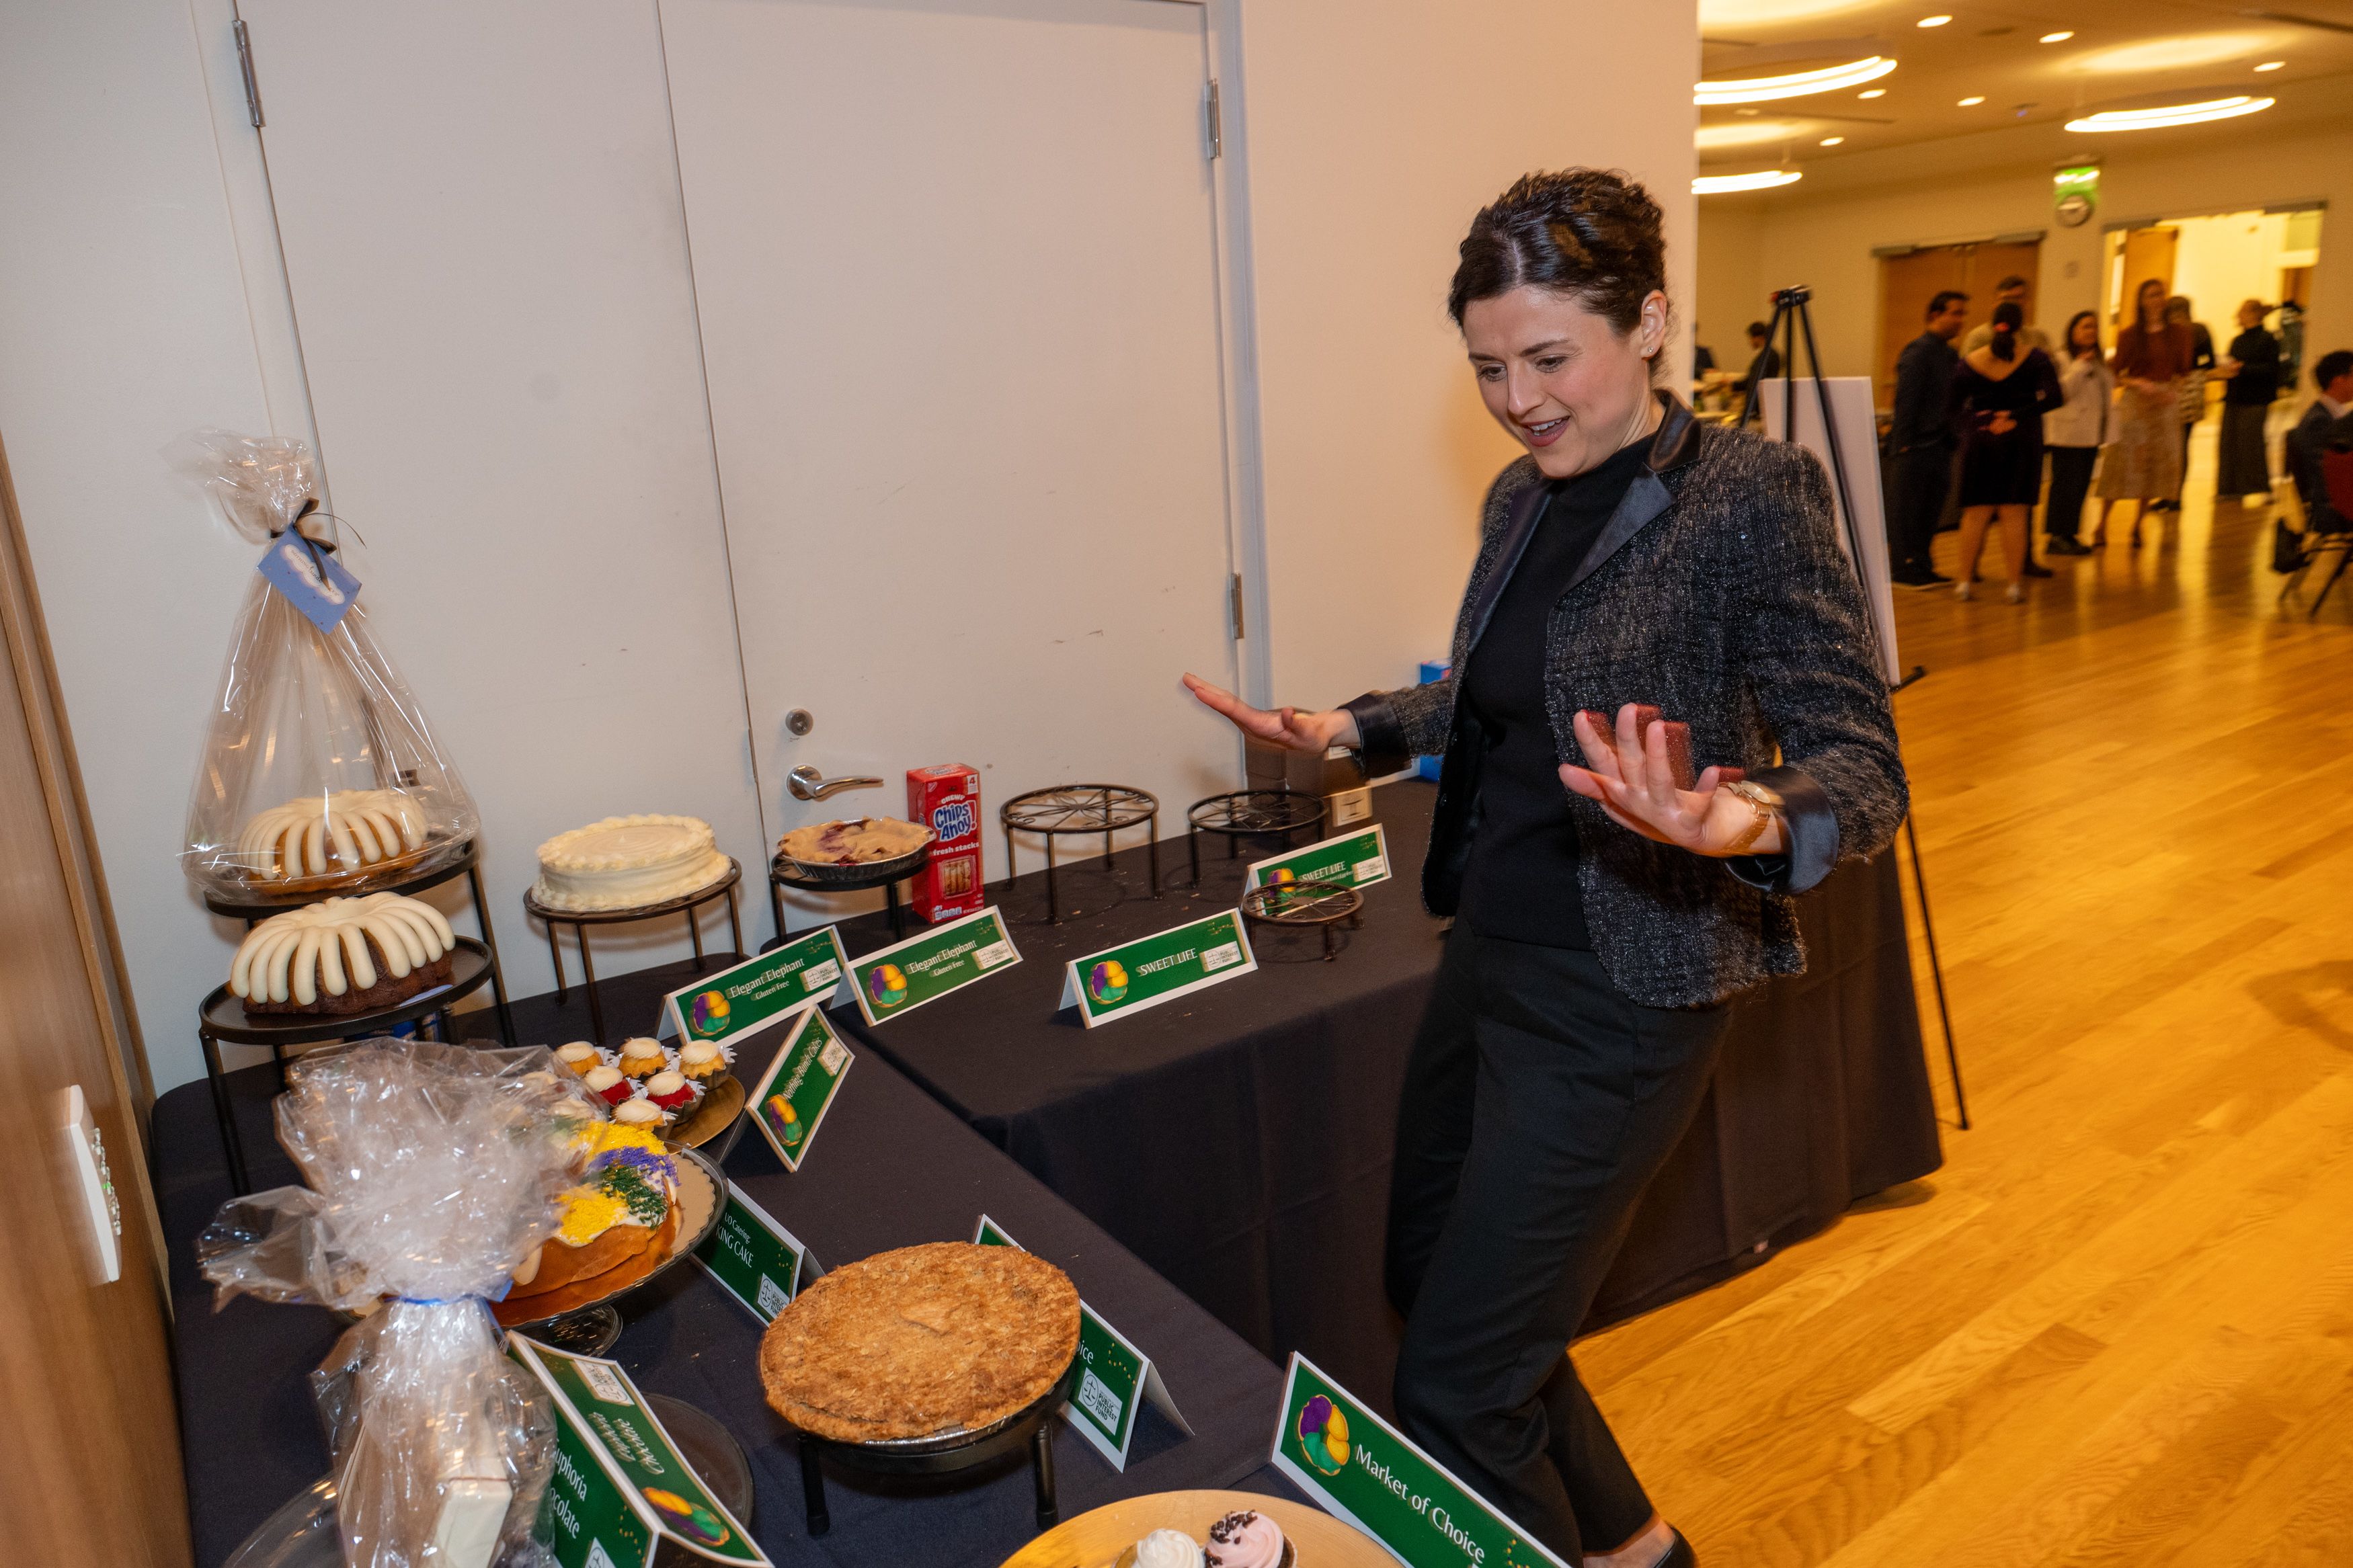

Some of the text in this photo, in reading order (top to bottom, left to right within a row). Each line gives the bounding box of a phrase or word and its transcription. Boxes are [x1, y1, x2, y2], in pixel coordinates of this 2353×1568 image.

[934, 804, 969, 829] Chips
[933, 842, 980, 856] fresh stacks
[1302, 866, 1328, 881] SWEET
[1331, 861, 1346, 874] LIFE
[909, 940, 978, 973] Elegant Elephant
[934, 960, 965, 977] Gluten Free
[1139, 948, 1197, 977] SWEET LIFE
[730, 958, 805, 999] Elegant Elephant
[756, 981, 790, 1001] Gluten Free
[783, 1037, 822, 1102] Nothing Bundt Cakes
[725, 1212, 751, 1244] UO Catering:
[716, 1223, 754, 1268] KING CAKE
[1096, 1405, 1108, 1421] FUND
[1097, 1399, 1117, 1421] INTEREST
[1099, 1393, 1114, 1411] PUBLIC
[618, 1419, 664, 1473] Chocolate
[555, 1438, 588, 1501] uphoria
[1356, 1444, 1485, 1564] Market of Choice
